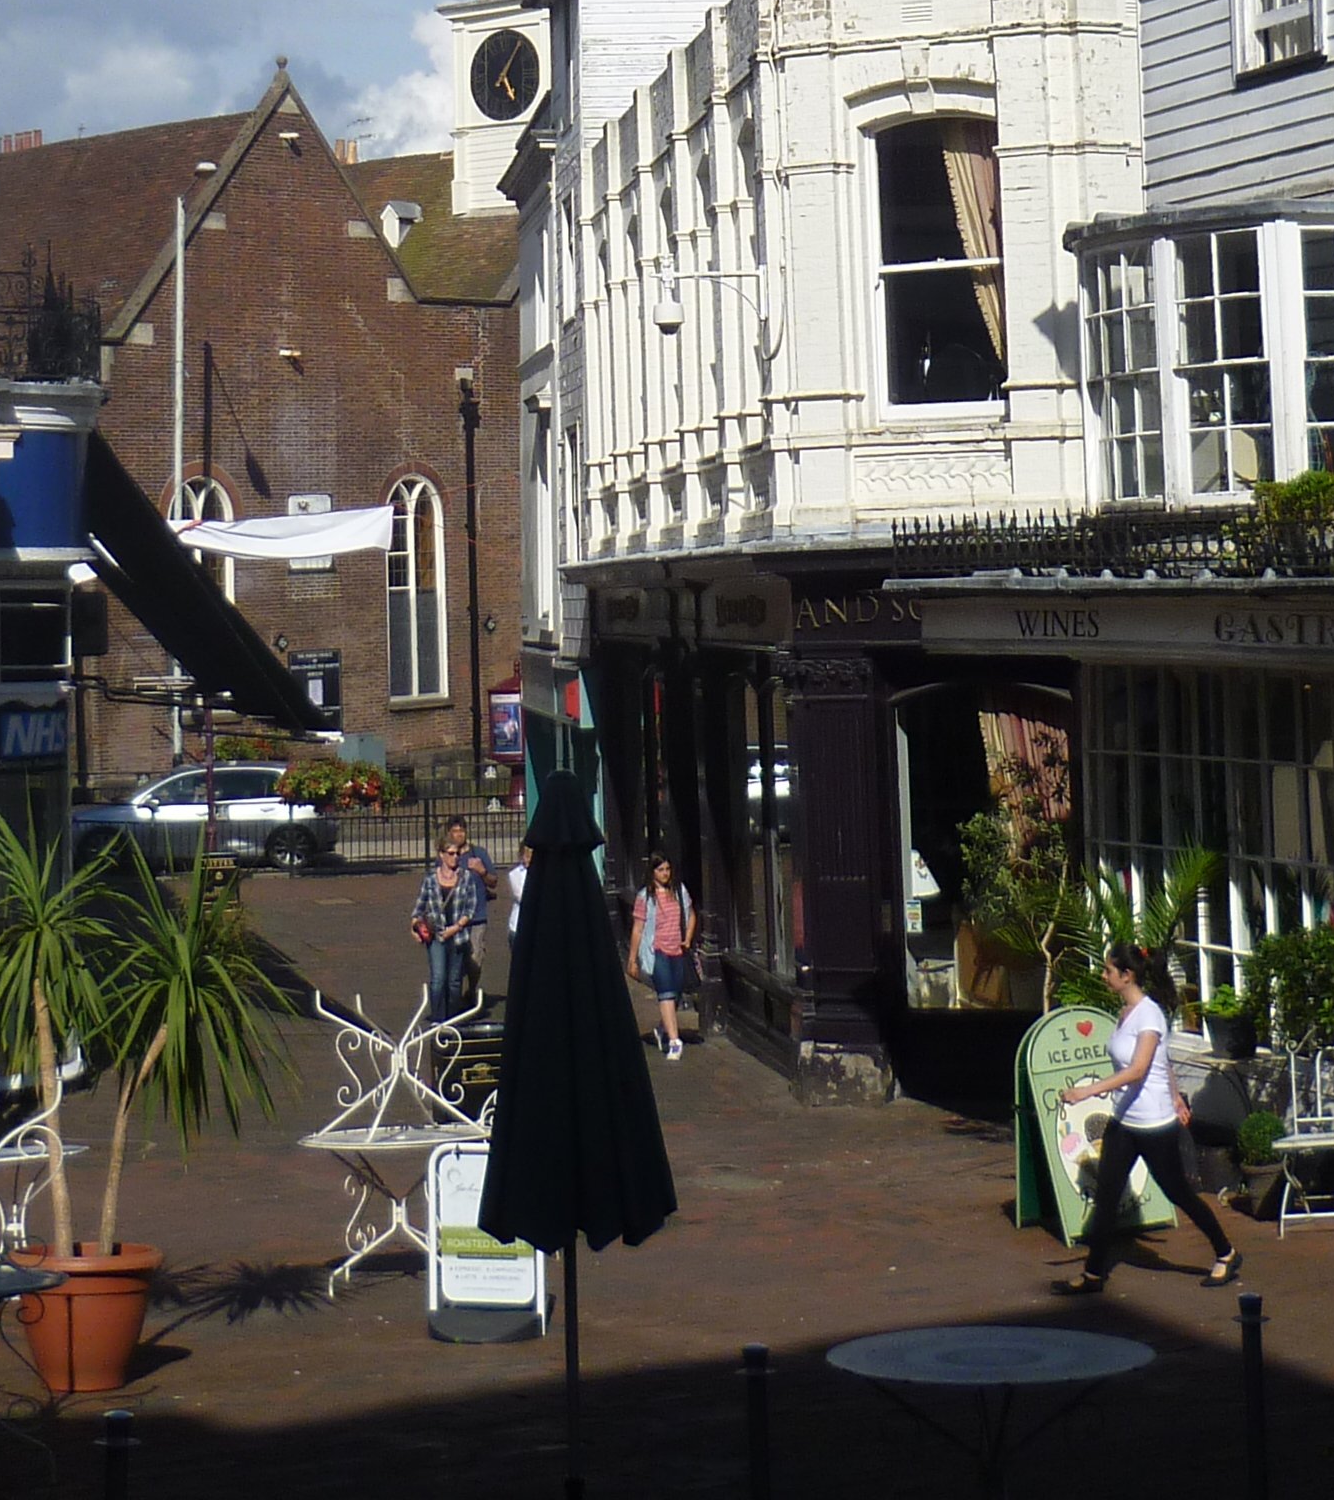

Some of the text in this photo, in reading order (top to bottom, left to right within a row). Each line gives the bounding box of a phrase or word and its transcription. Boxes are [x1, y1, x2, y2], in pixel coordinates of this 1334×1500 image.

[795, 595, 880, 629] AND
[1016, 609, 1100, 638] WINES
[4, 712, 67, 756] NHS
[1058, 1027, 1070, 1042] I
[1048, 1044, 1107, 1064] ICE CRE
[446, 1238, 491, 1250] ROASTED
